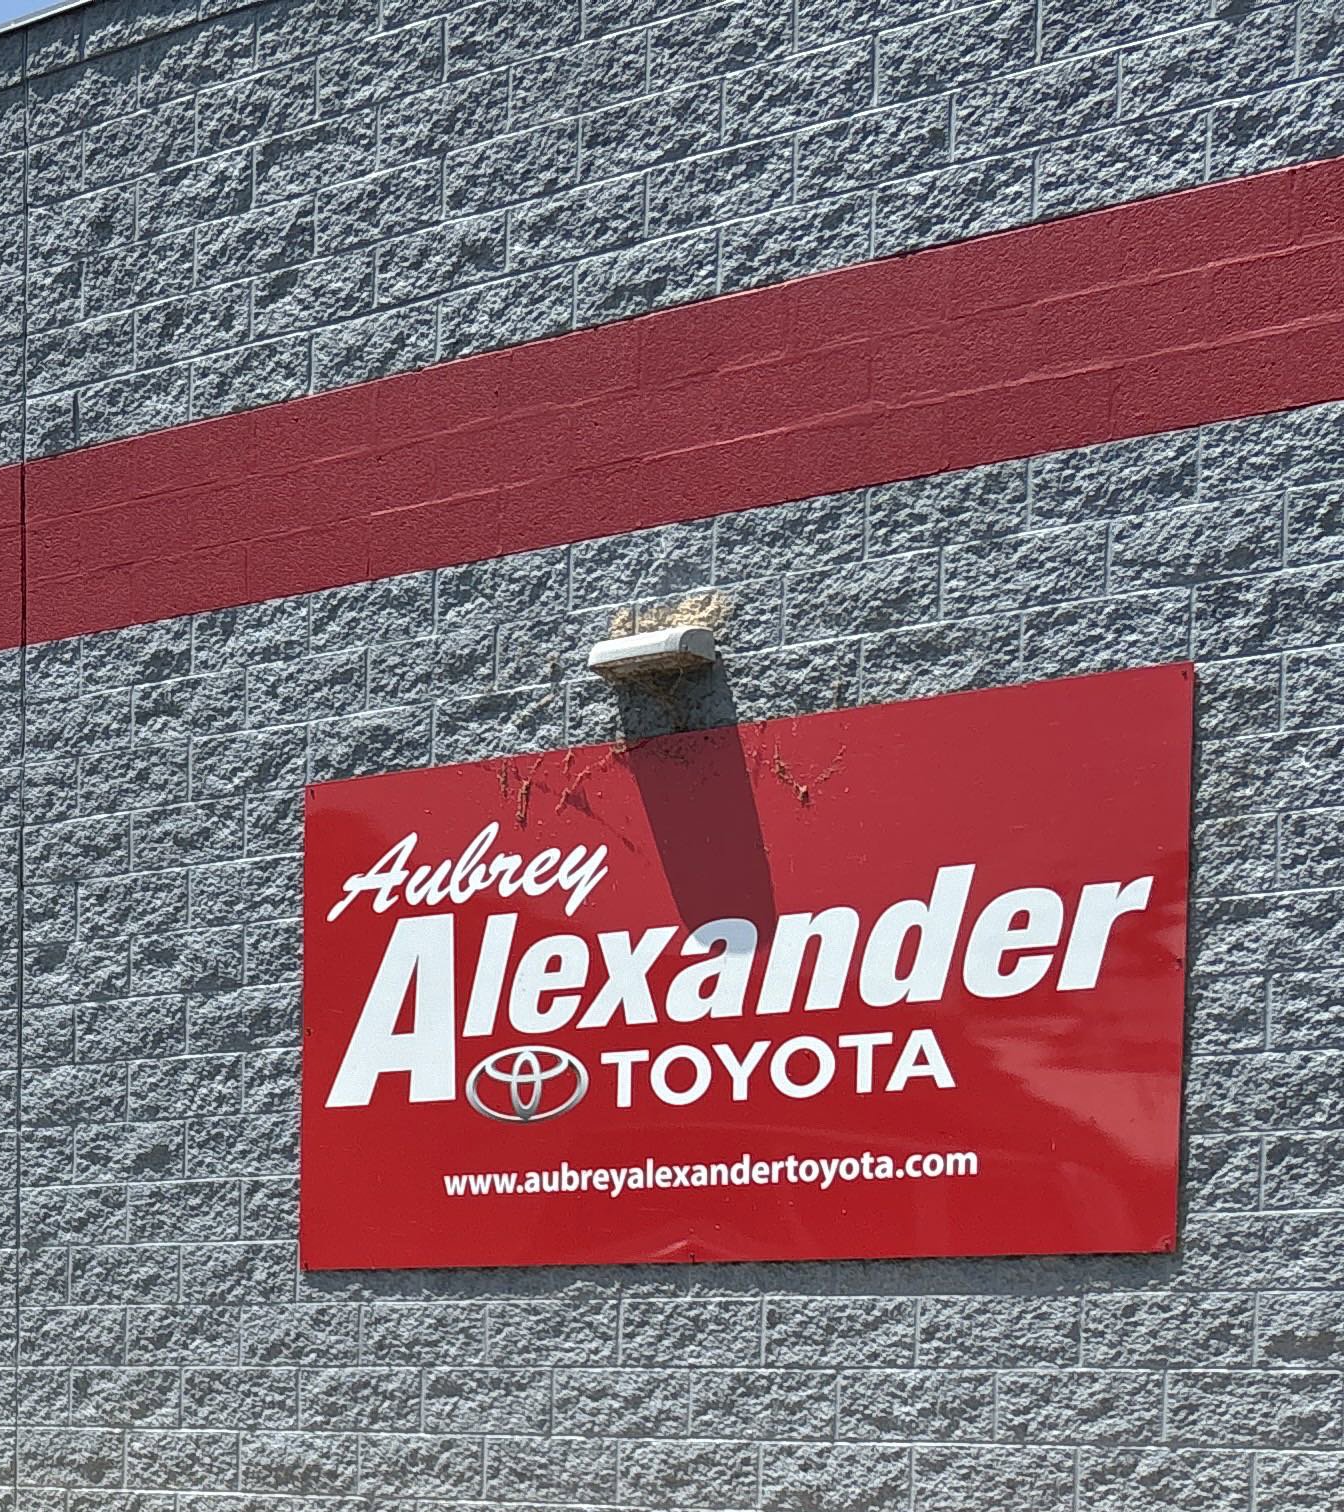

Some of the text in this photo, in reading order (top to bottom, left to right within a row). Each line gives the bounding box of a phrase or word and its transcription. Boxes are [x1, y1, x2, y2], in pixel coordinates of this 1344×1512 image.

[326, 821, 609, 923] Aubrey
[324, 862, 1155, 1109] Alexander
[600, 1028, 957, 1109] TOYOTA
[443, 1151, 979, 1198] www.aubreyalexandertoyota.com
